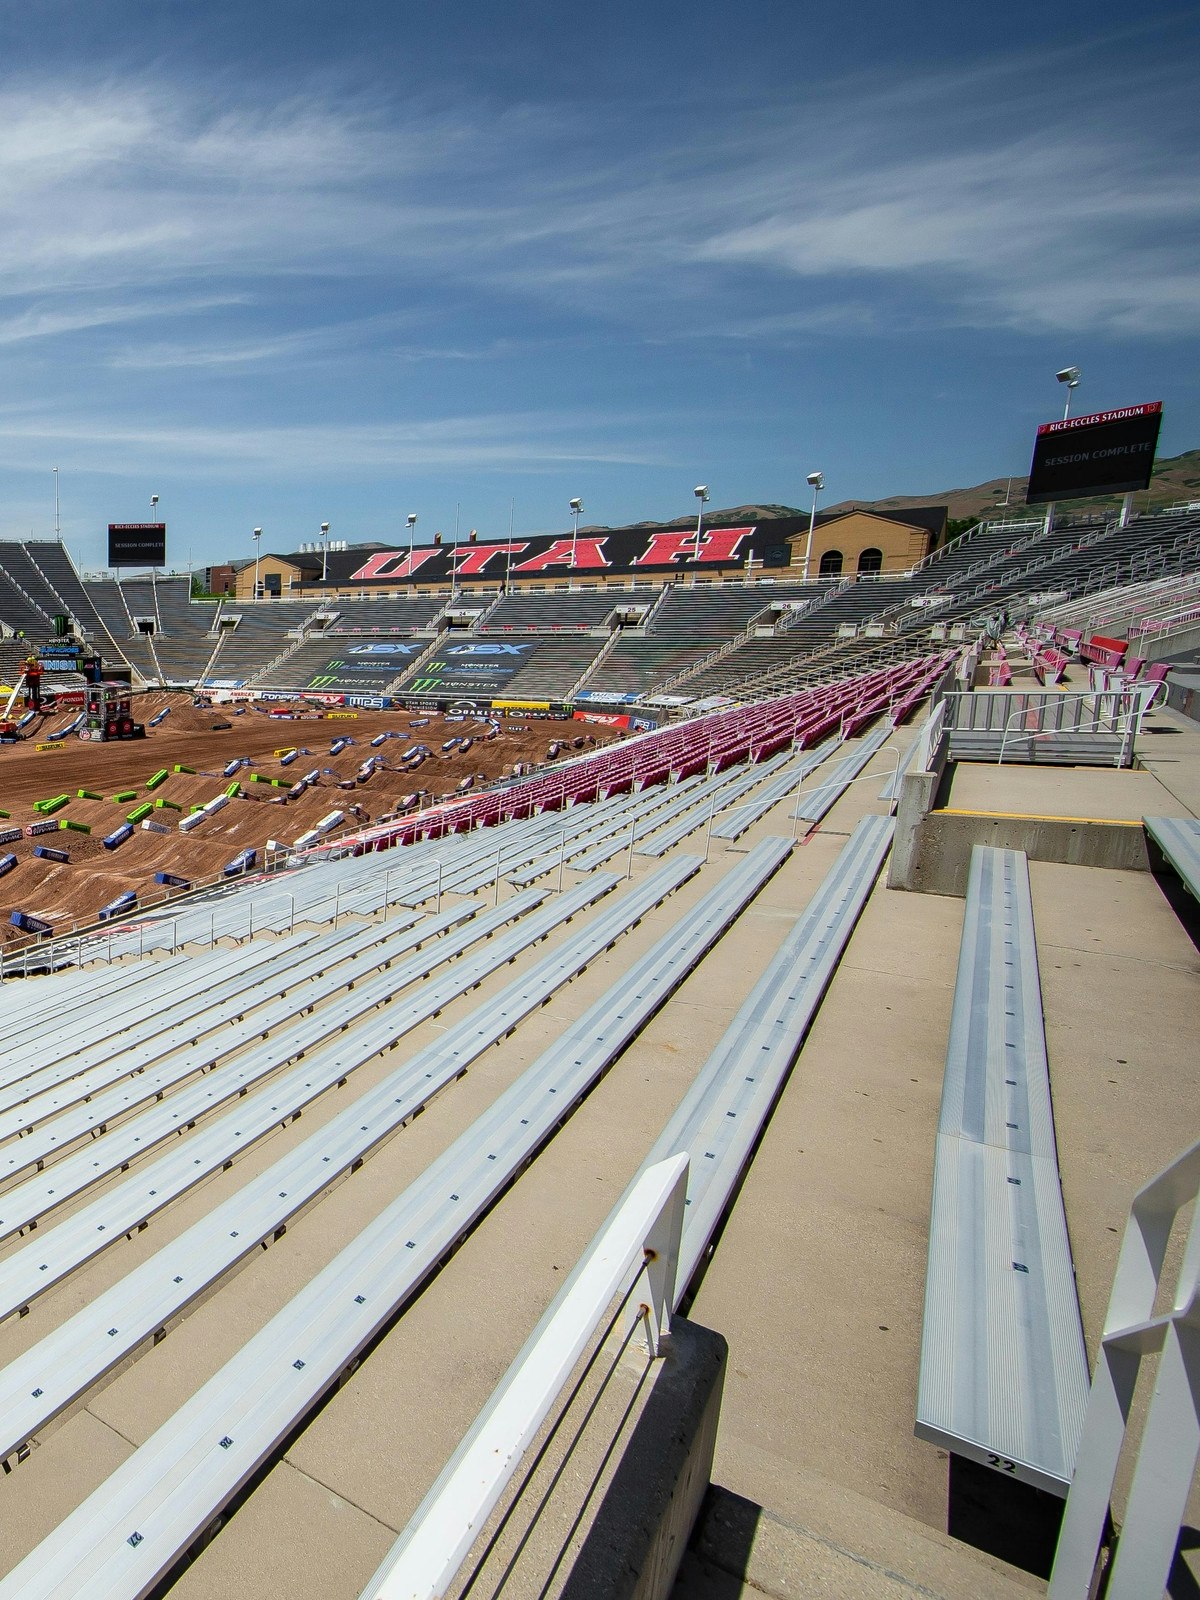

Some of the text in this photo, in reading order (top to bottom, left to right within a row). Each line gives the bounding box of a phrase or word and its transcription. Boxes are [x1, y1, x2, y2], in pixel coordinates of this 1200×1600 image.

[1049, 406, 1144, 432] RICE-ECCLES STADIUM
[1044, 441, 1151, 467] SESSION COMPLETE
[350, 526, 757, 580] UTAH
[988, 1454, 1016, 1474] 22
